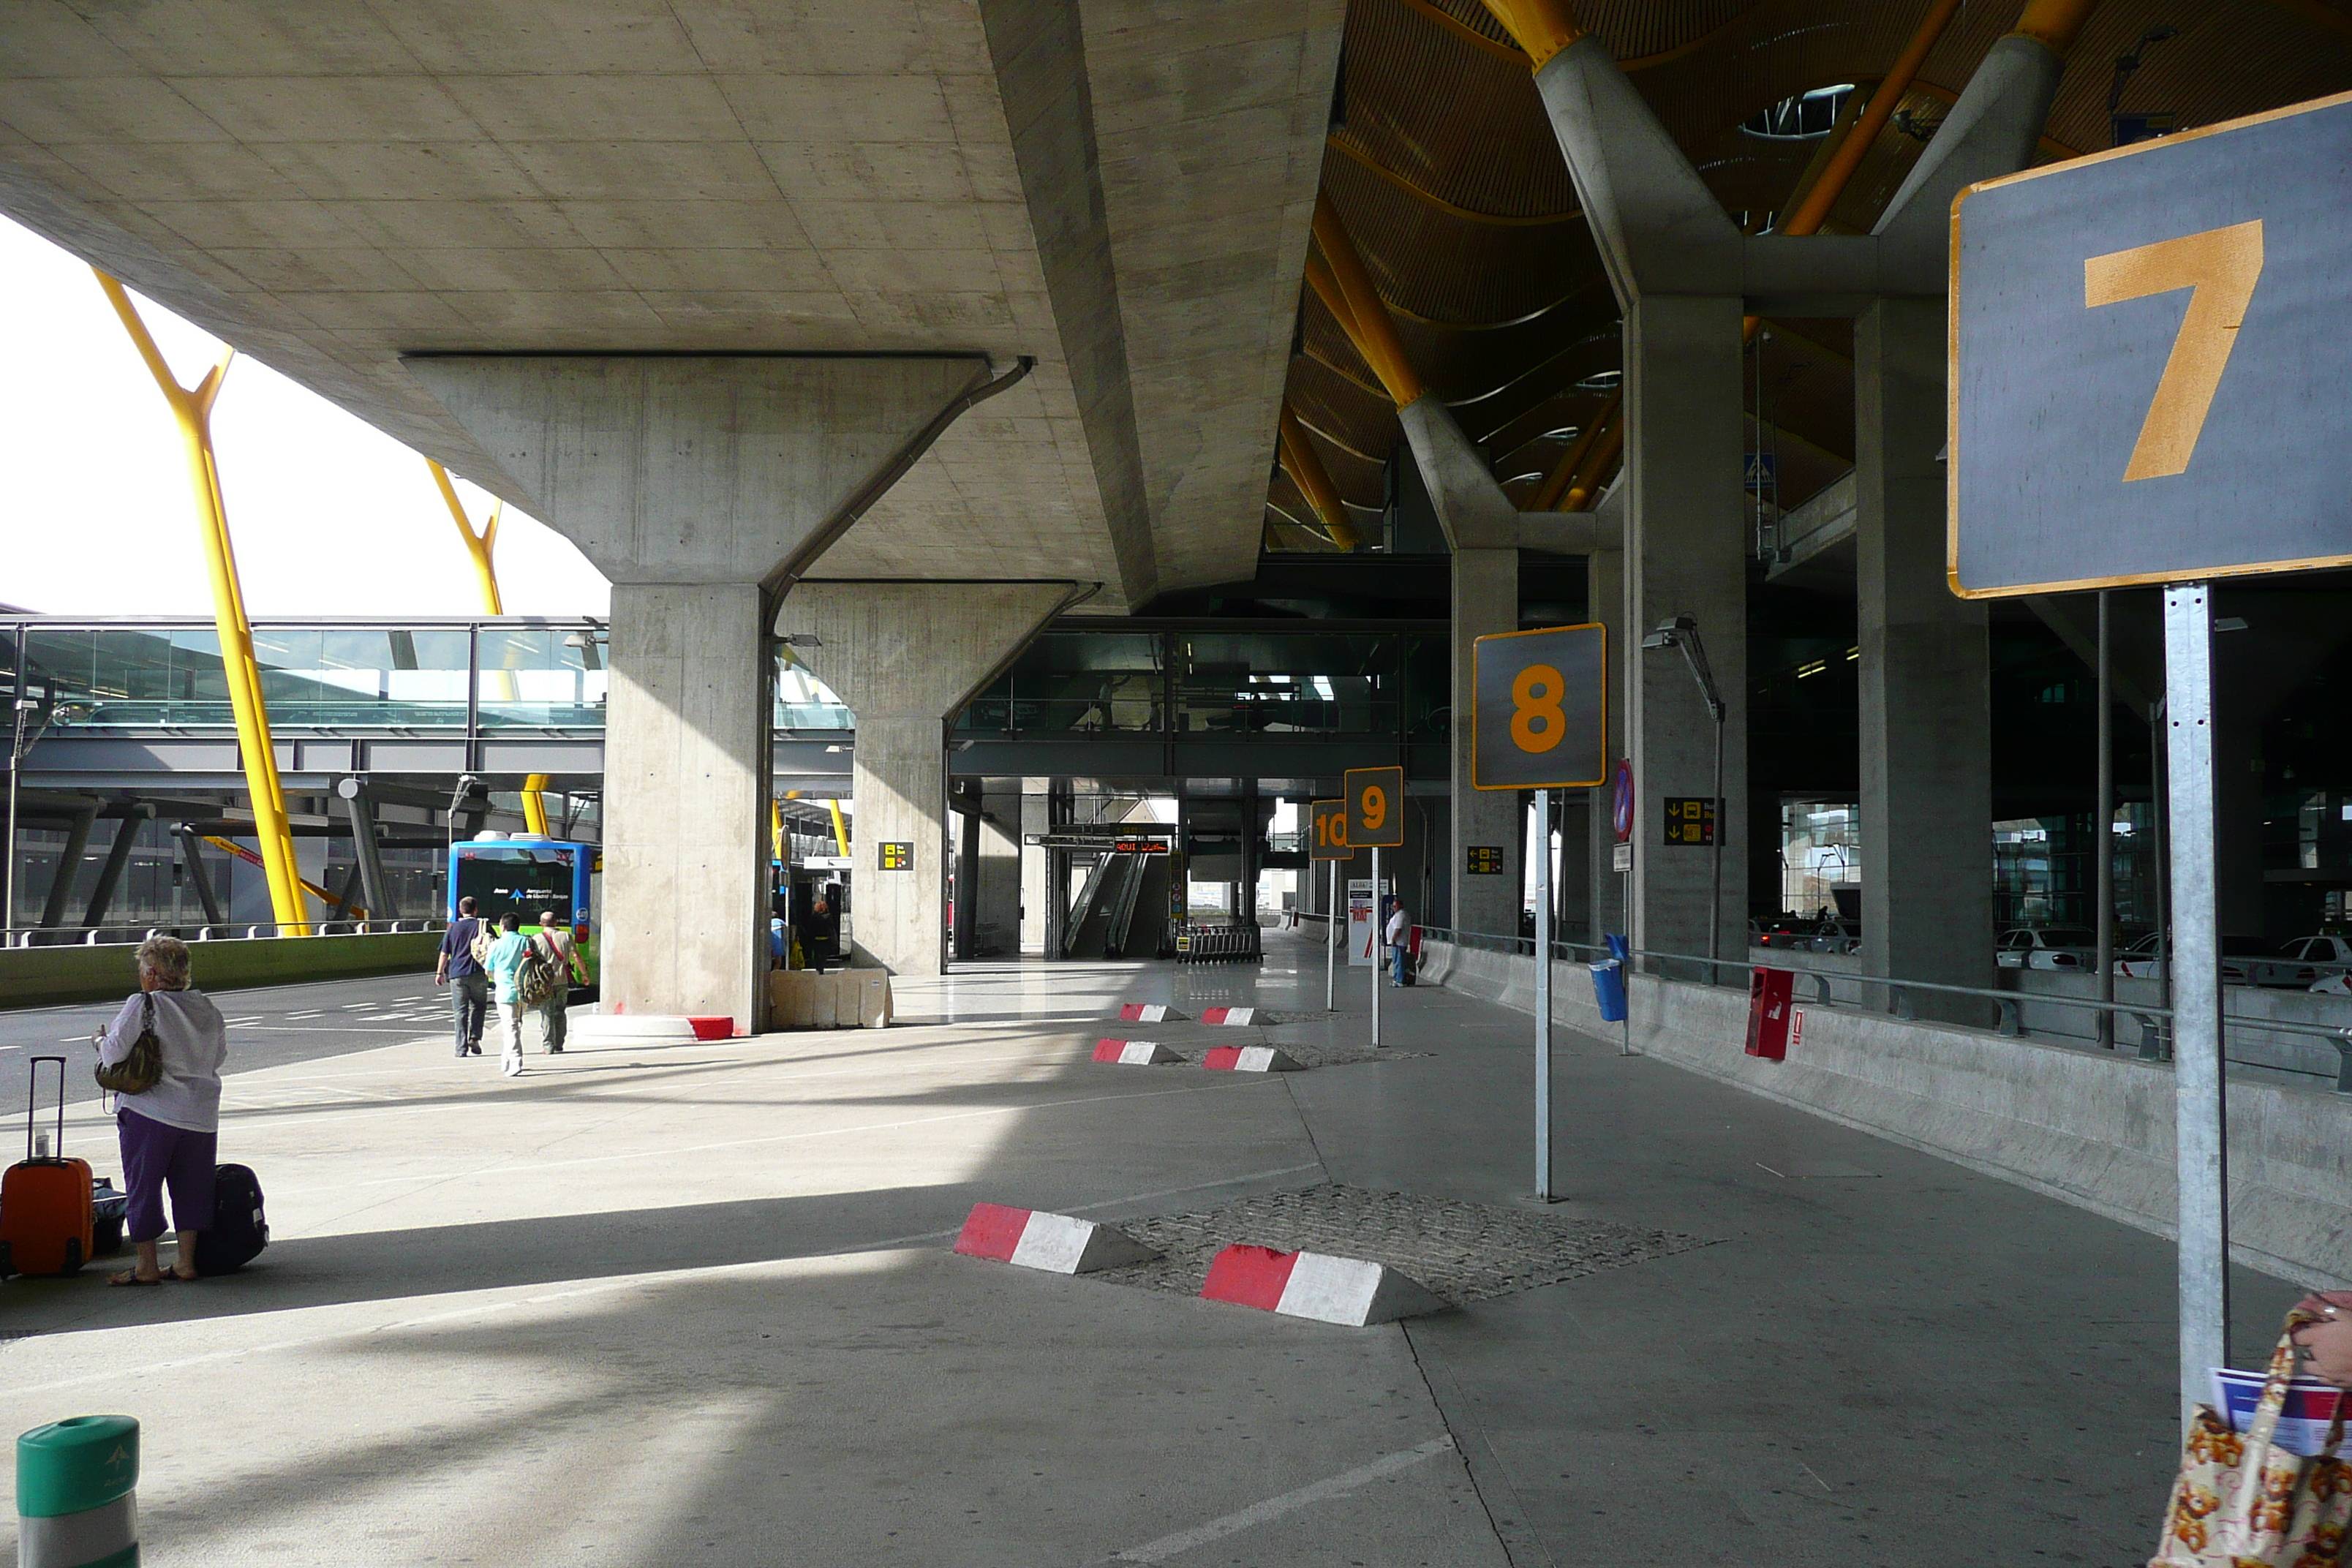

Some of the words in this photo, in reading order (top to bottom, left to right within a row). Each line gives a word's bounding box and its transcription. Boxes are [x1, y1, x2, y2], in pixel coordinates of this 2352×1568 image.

[2084, 219, 2264, 482] 7
[1510, 664, 1567, 754] 8
[1316, 813, 1346, 847] 10
[1362, 785, 1386, 830] 9
[1704, 811, 1715, 819] Bu
